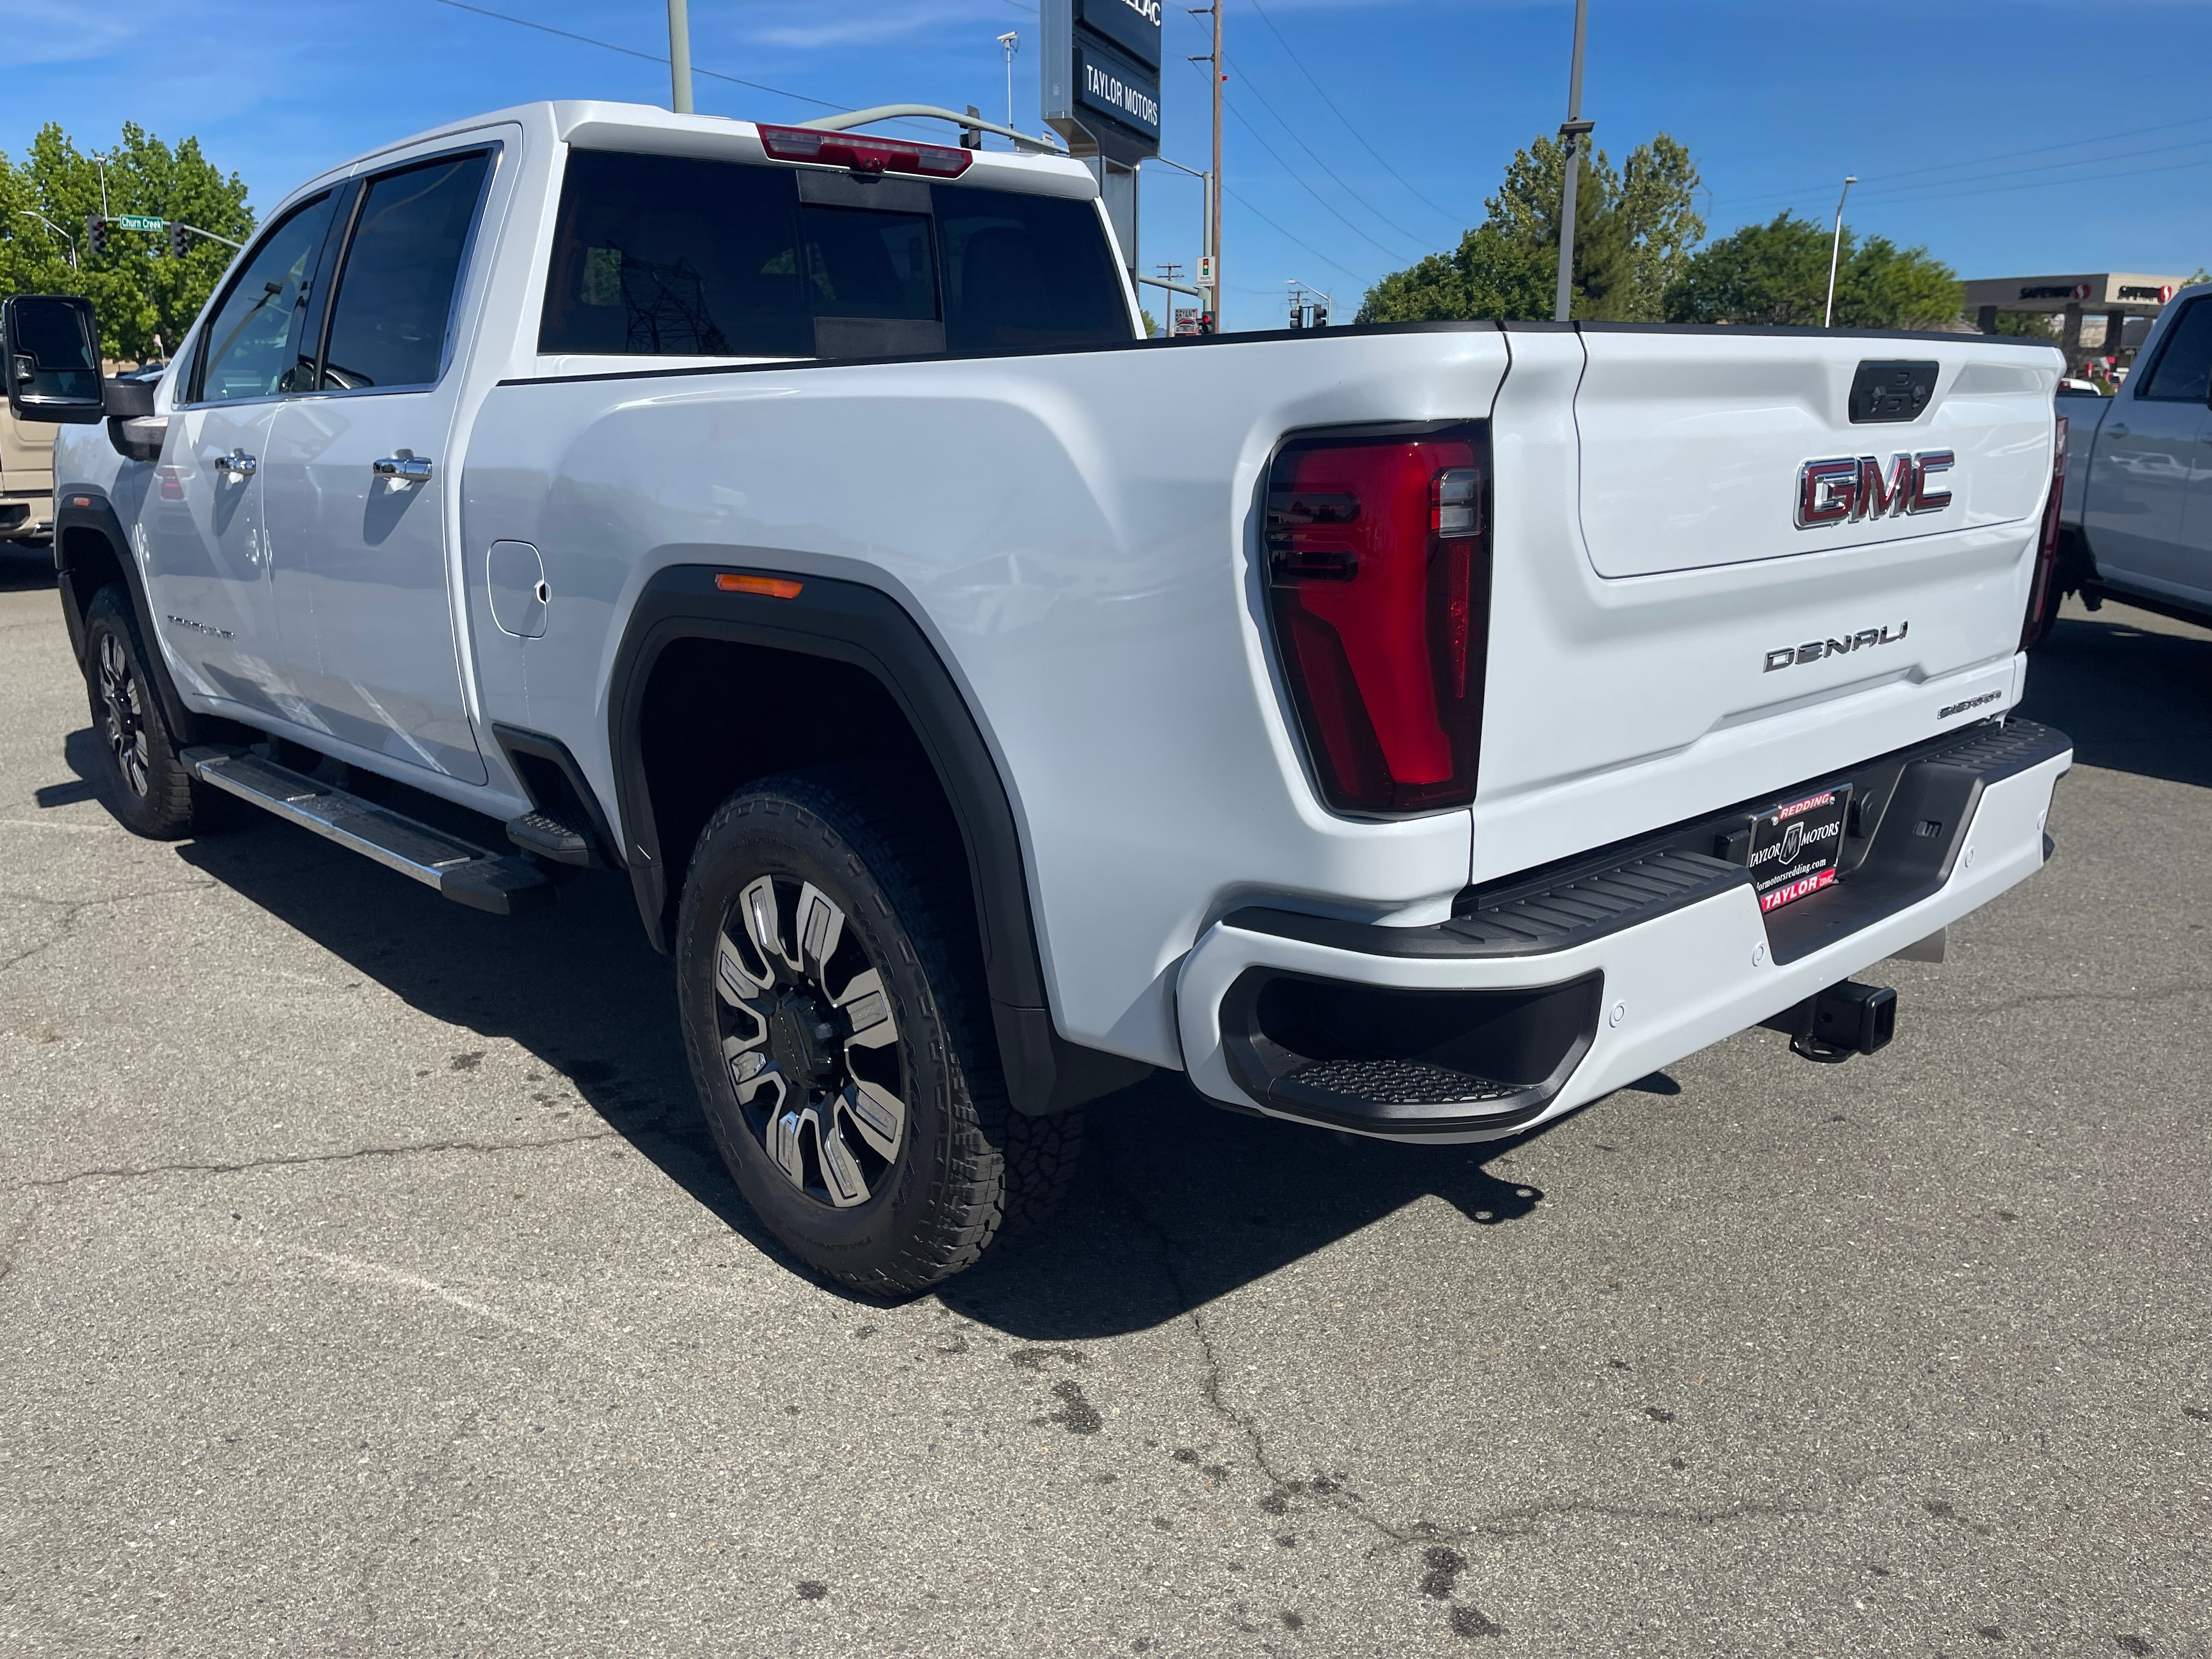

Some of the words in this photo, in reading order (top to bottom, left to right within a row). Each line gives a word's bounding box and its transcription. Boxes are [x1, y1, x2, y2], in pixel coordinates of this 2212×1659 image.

[1122, 0, 1161, 26] LAC
[1087, 64, 1122, 108] TAYLOR
[1125, 86, 1158, 126] MOTORS
[122, 217, 141, 228] Churn
[143, 218, 161, 229] Creek
[1793, 449, 1955, 531] GMC
[1763, 620, 1908, 673] DENALI
[1779, 793, 1830, 819] REDDING
[1750, 842, 1781, 868] TAYLOR
[1801, 821, 1840, 847] MOTORS
[1765, 876, 1818, 910] TAYLOR
